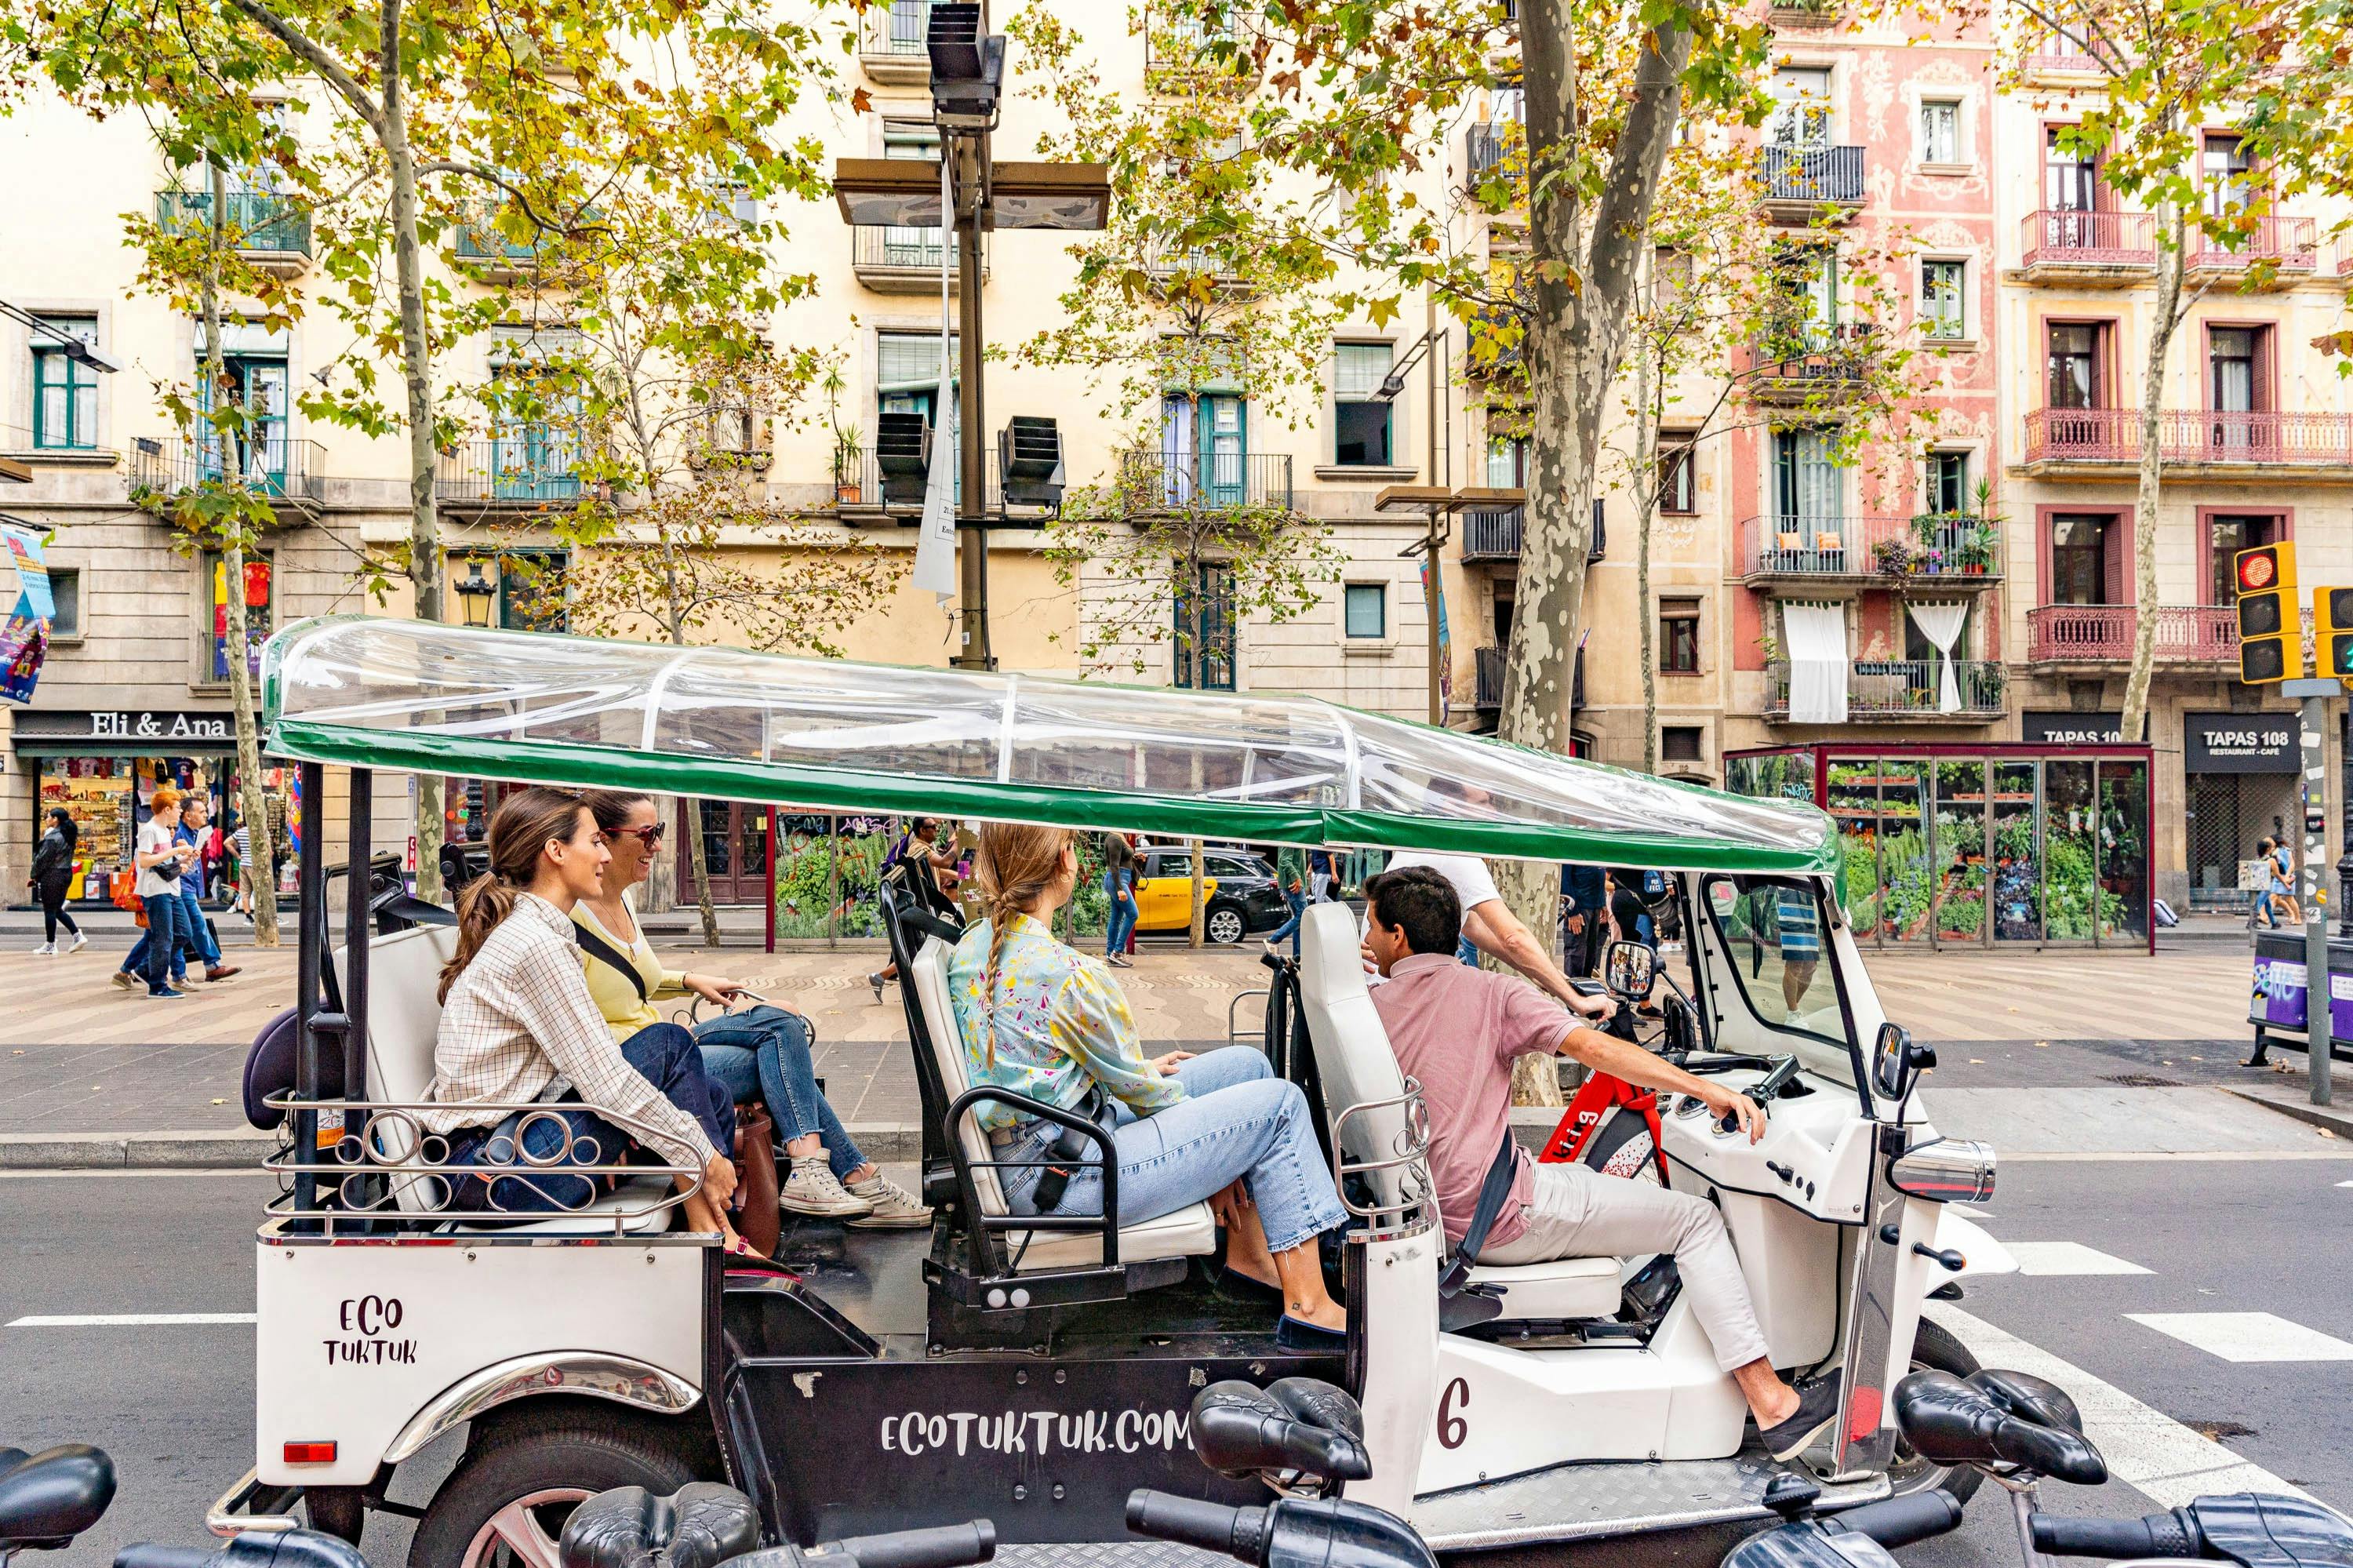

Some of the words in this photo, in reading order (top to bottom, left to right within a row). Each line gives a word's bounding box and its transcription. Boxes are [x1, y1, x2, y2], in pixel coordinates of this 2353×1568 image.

[90, 711, 129, 736] Eli
[136, 712, 162, 737] &
[168, 713, 226, 737] Ana
[2044, 731, 2098, 742] TAPAS
[2102, 731, 2121, 742] 10
[2203, 731, 2258, 746] TAPAS
[2260, 732, 2289, 746] 108
[1552, 1111, 1598, 1159] bicing
[340, 1295, 403, 1336] ECO
[322, 1339, 417, 1366] TUKTUK
[1437, 1377, 1470, 1450] 6
[881, 1410, 1195, 1456] ECOTUKTUK.COM
